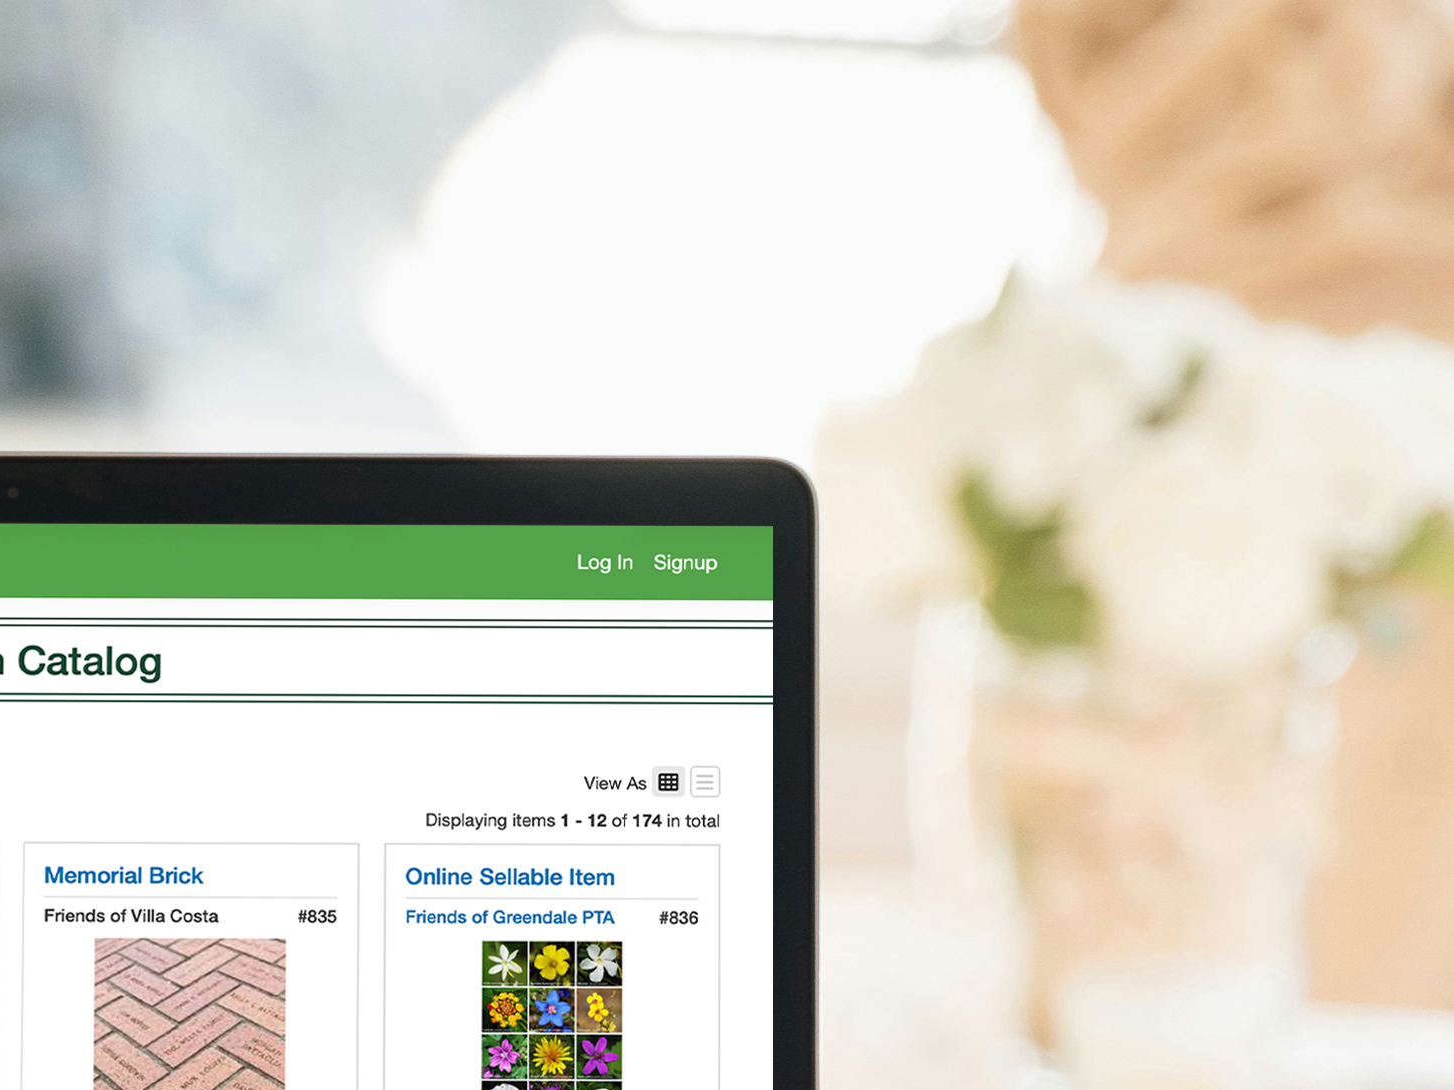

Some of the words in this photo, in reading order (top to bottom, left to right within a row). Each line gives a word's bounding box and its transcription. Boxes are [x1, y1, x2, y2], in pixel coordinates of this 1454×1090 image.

[578, 554, 611, 574] Log
[618, 554, 632, 569] In
[654, 554, 717, 574] Signup
[18, 645, 161, 683] Catalog
[584, 776, 622, 790] View
[627, 777, 647, 790] As
[426, 813, 507, 830] Displaying
[513, 813, 555, 827] items
[561, 814, 567, 827] 1
[588, 814, 607, 827] 12
[612, 814, 627, 827] of
[633, 814, 662, 827] 174
[667, 814, 680, 827] in
[685, 814, 719, 828] total
[45, 866, 142, 884] Memorial
[150, 867, 204, 884] Brick
[406, 867, 472, 885] Online
[480, 868, 562, 886] Sellable
[570, 868, 614, 886] Item
[45, 909, 105, 922] Friends
[111, 909, 126, 922] of
[131, 909, 165, 923] Villa
[170, 909, 219, 923] Costa
[298, 910, 337, 923] #835
[406, 910, 467, 924] Friends
[472, 910, 488, 924] of
[493, 910, 577, 924] Greendale
[583, 910, 615, 924] PTA
[659, 911, 698, 925] #836
